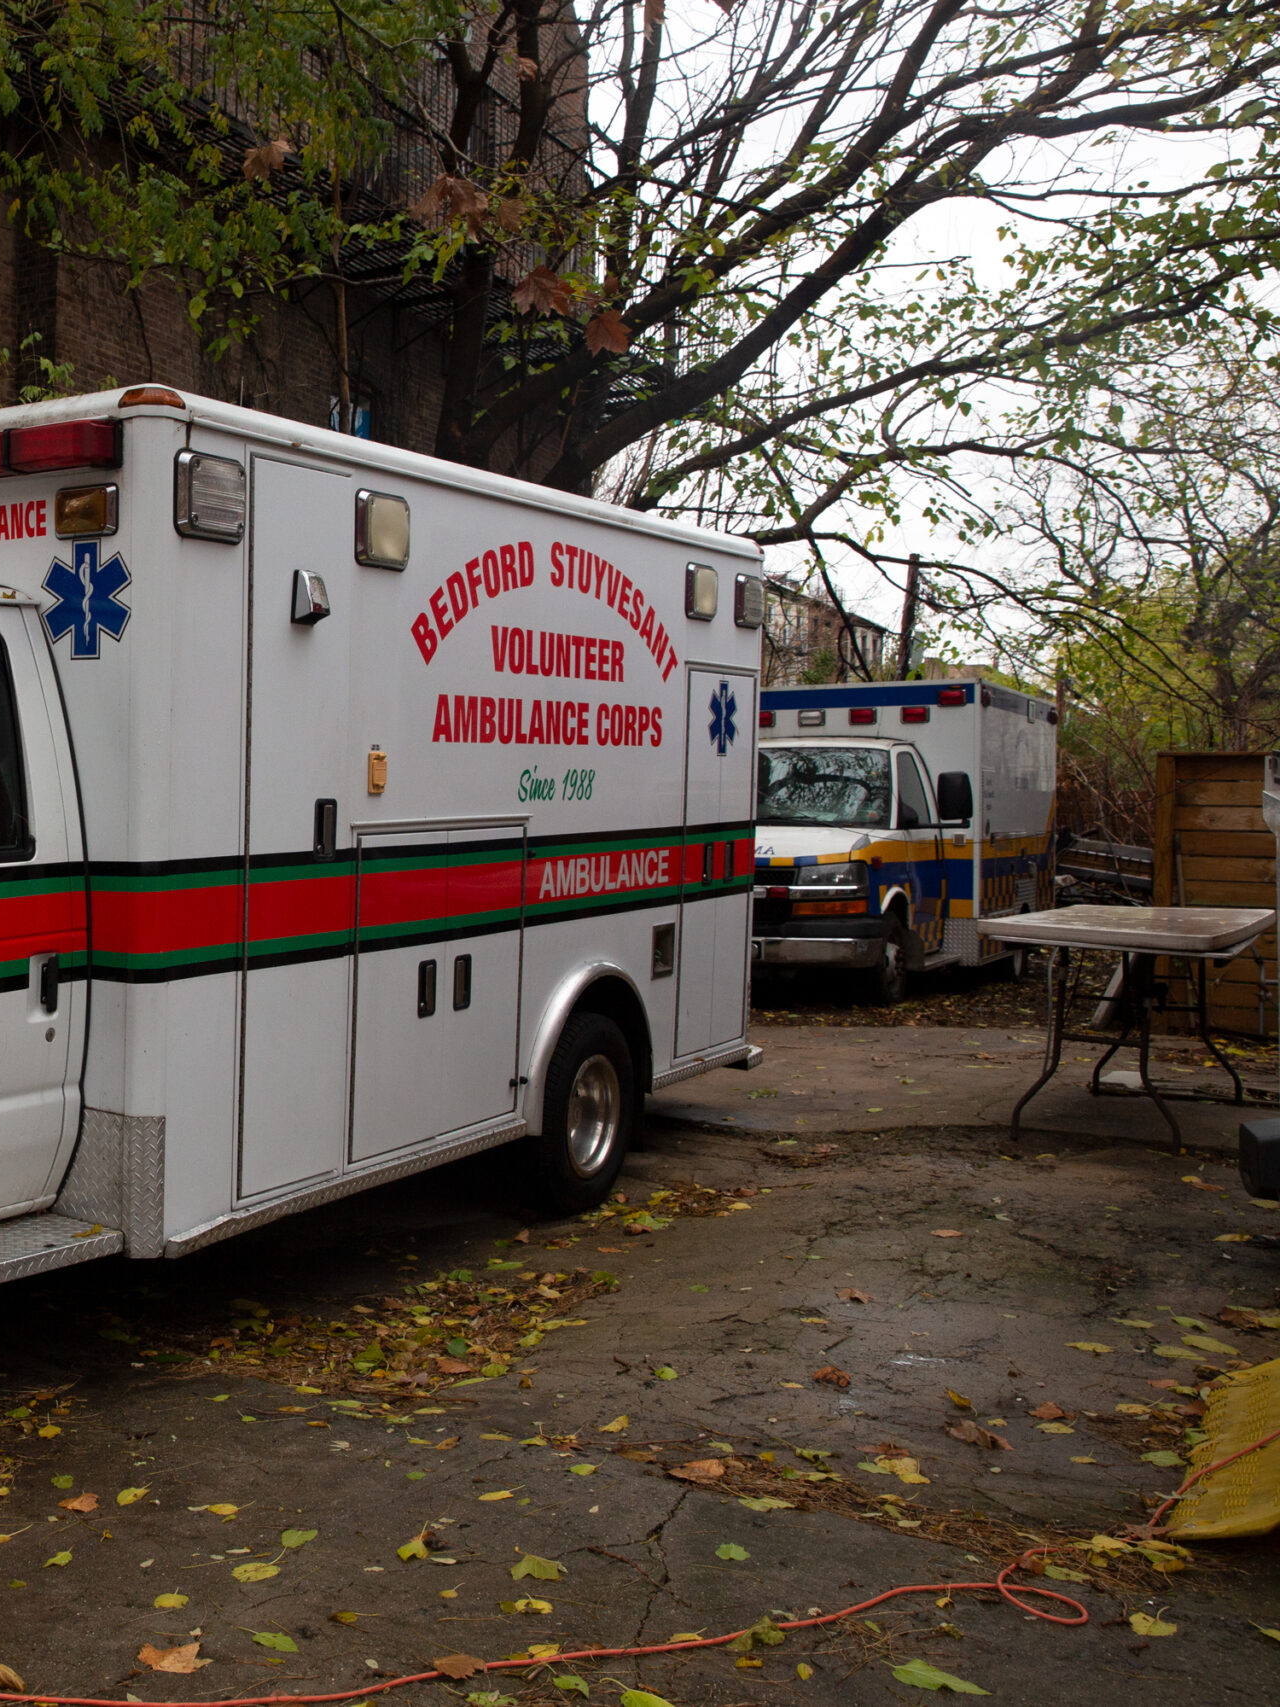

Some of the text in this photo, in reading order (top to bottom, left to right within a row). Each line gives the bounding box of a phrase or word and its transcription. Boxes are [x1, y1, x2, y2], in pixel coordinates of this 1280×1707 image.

[410, 540, 679, 683] BEDFORD STUYVESANT
[490, 624, 625, 683] VOLUNTEER
[431, 693, 663, 748] AMBULANCE CORPS
[517, 764, 596, 804] Since 1988
[539, 850, 670, 899] AMBULANCE
